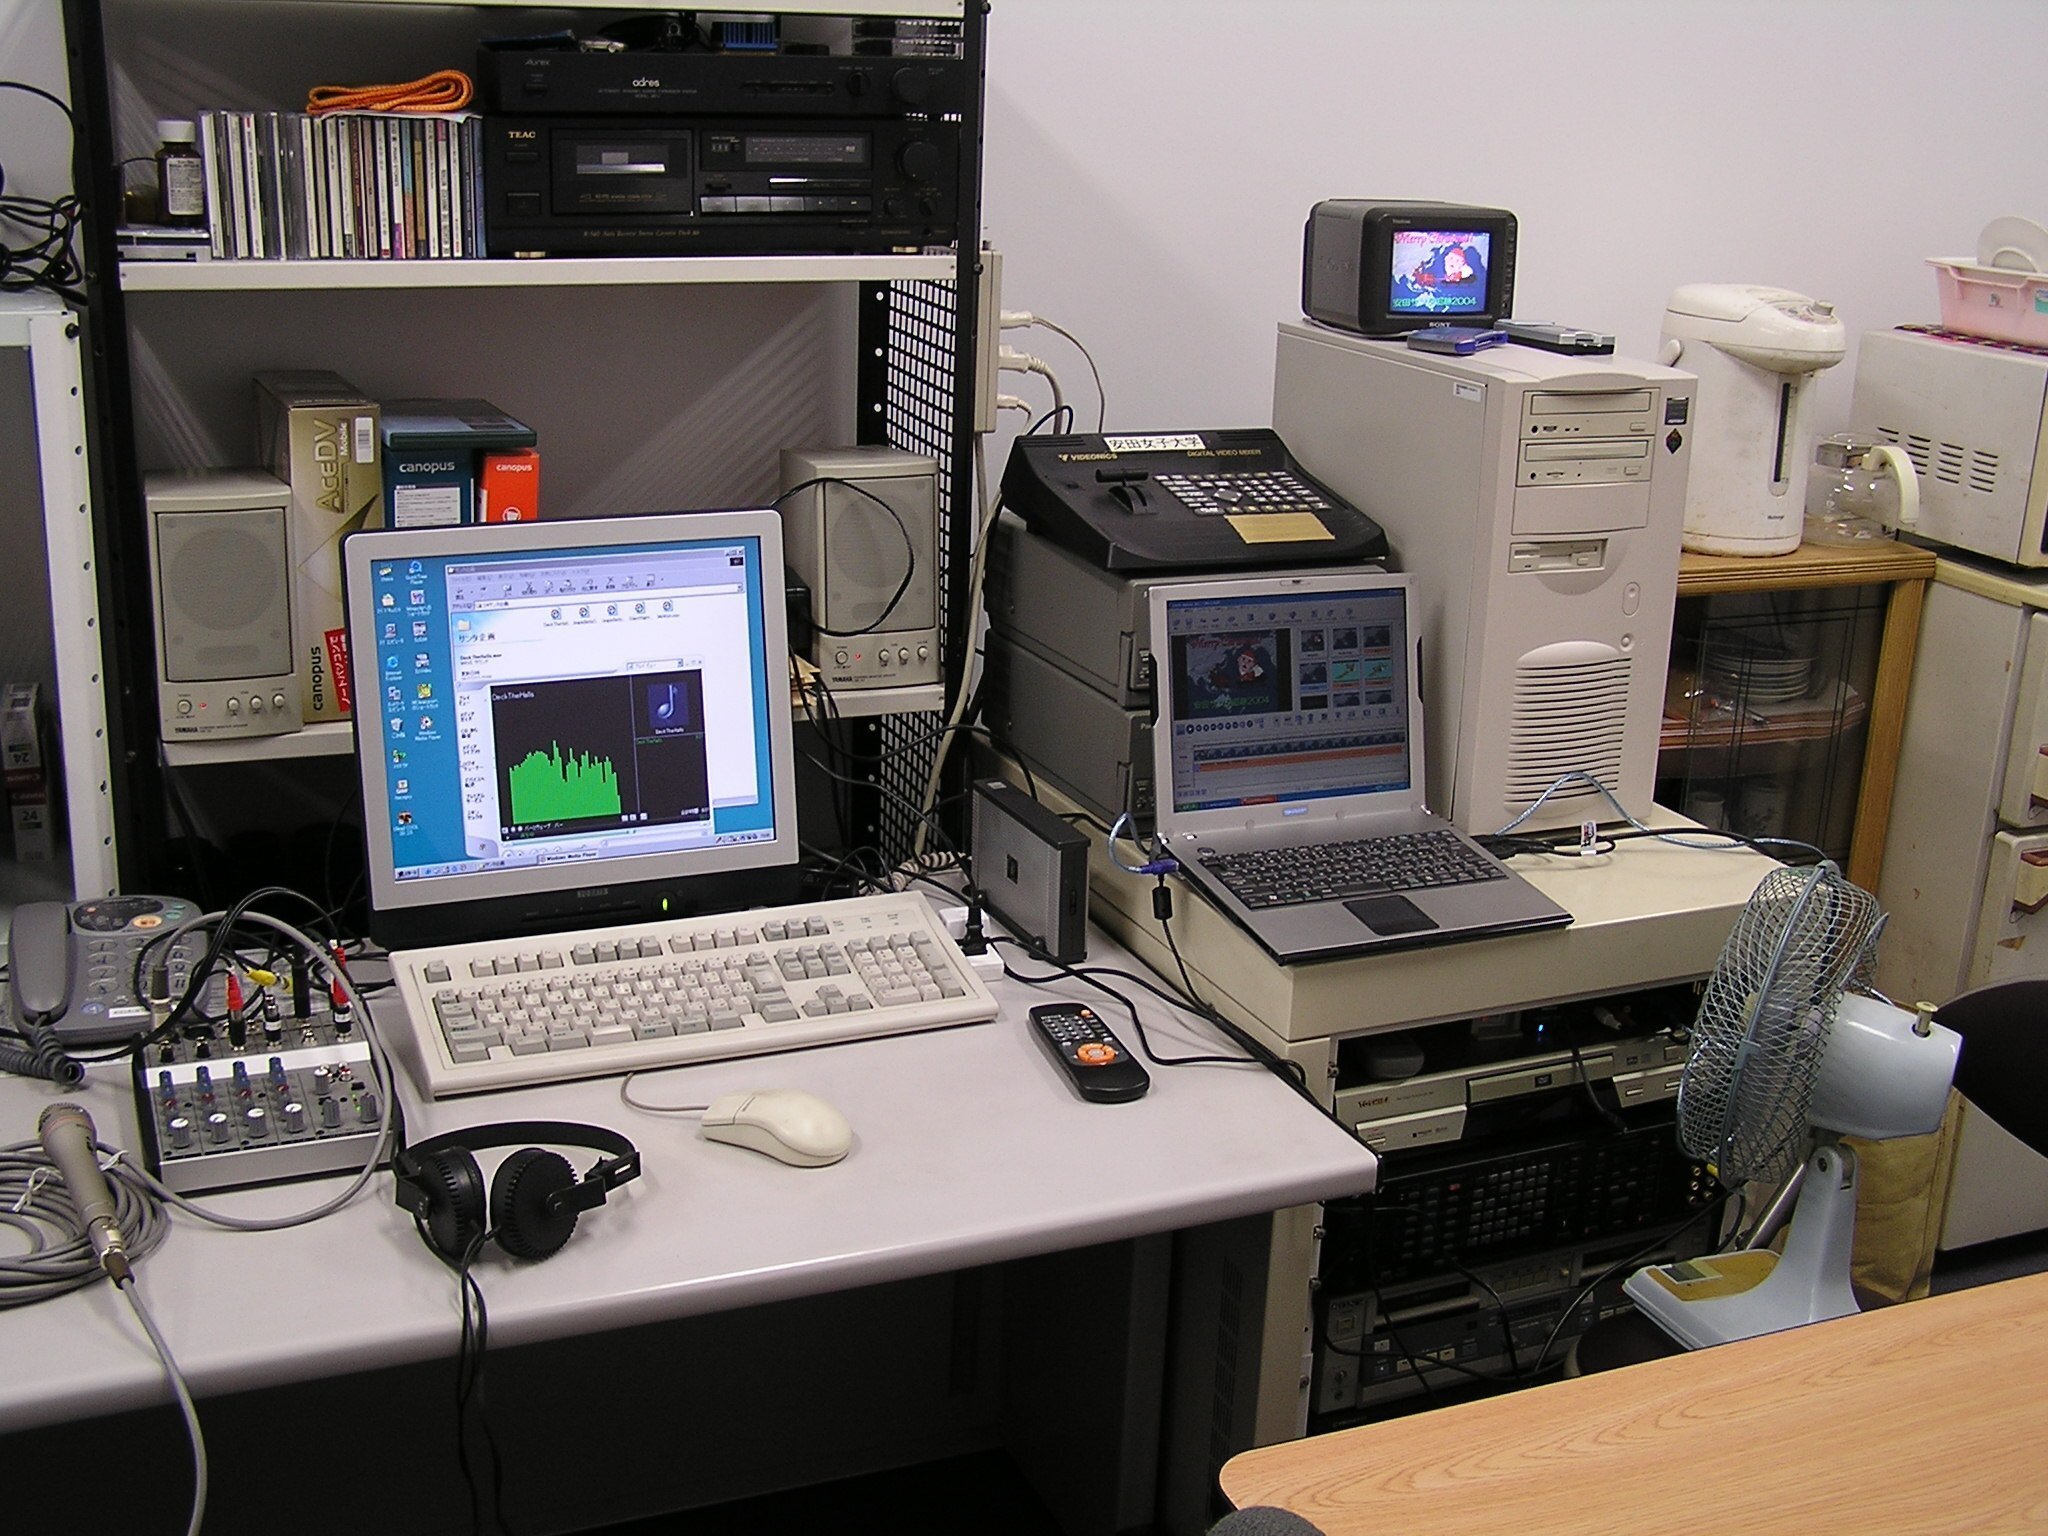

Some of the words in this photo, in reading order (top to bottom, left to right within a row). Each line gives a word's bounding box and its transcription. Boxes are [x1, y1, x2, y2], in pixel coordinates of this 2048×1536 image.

[508, 131, 536, 139] TEAC
[339, 421, 348, 457] Mobile
[1108, 437, 1202, 450] 安田女子大学
[1071, 453, 1118, 462] VIDEONICS
[1187, 450, 1214, 458] DIGITAL
[399, 460, 456, 474] canopus
[496, 463, 533, 473] canopus
[310, 646, 325, 711] canopus
[22, 810, 38, 821] 24
